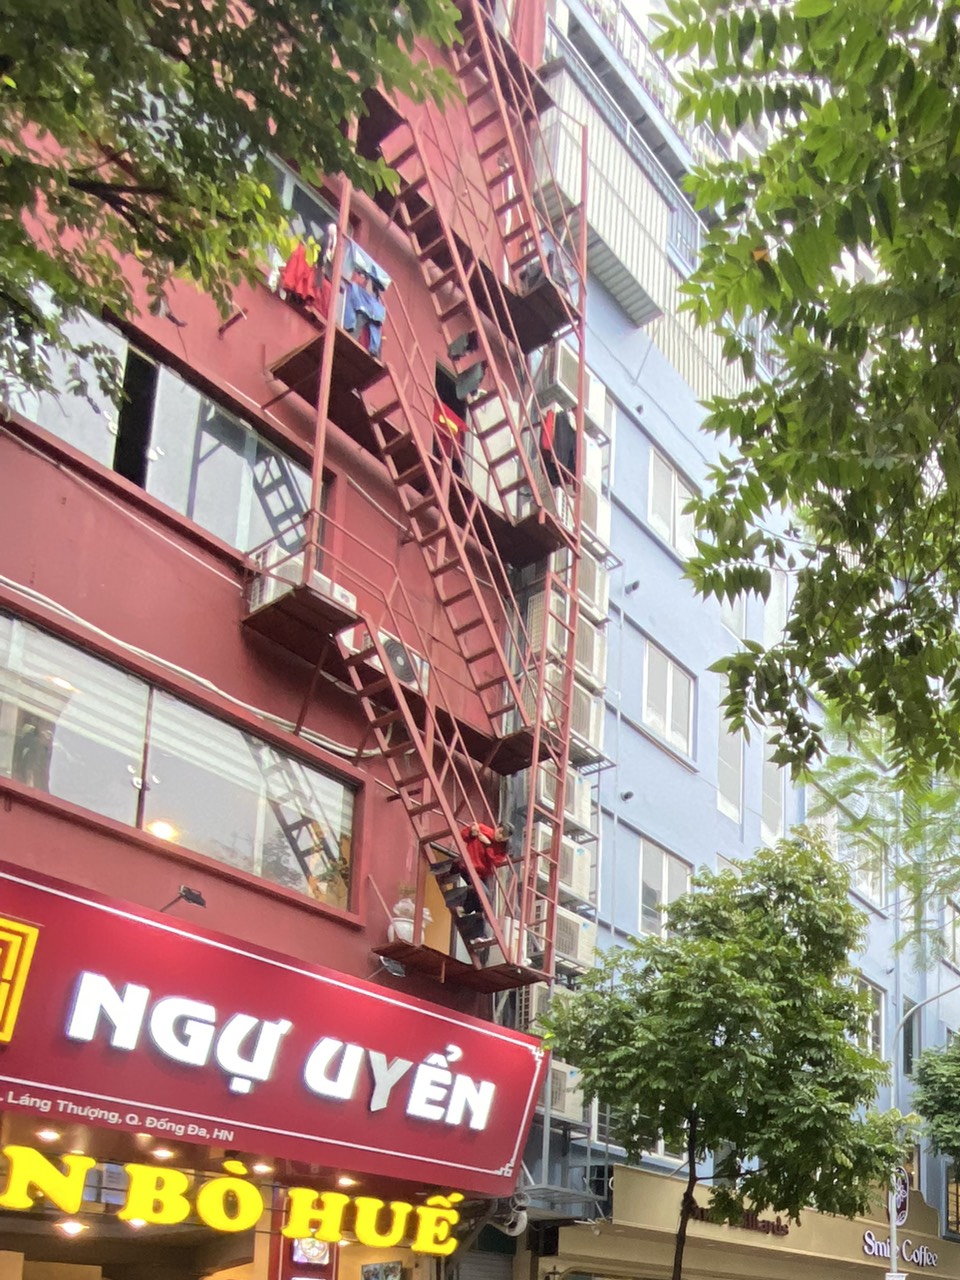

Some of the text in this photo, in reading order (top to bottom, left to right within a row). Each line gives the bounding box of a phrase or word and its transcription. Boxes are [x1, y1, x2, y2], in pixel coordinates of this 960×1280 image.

[65, 969, 497, 1132] NGỰ UYỂN
[6, 1090, 52, 1113] Láng
[56, 1099, 123, 1125] Thượng,
[125, 1112, 142, 1126] Q.
[145, 1114, 186, 1136] Đống
[212, 1128, 235, 1142] HN
[117, 1159, 265, 1233] BÒ
[280, 1191, 465, 1257] HUẾ
[901, 1239, 938, 1267] Coffee
